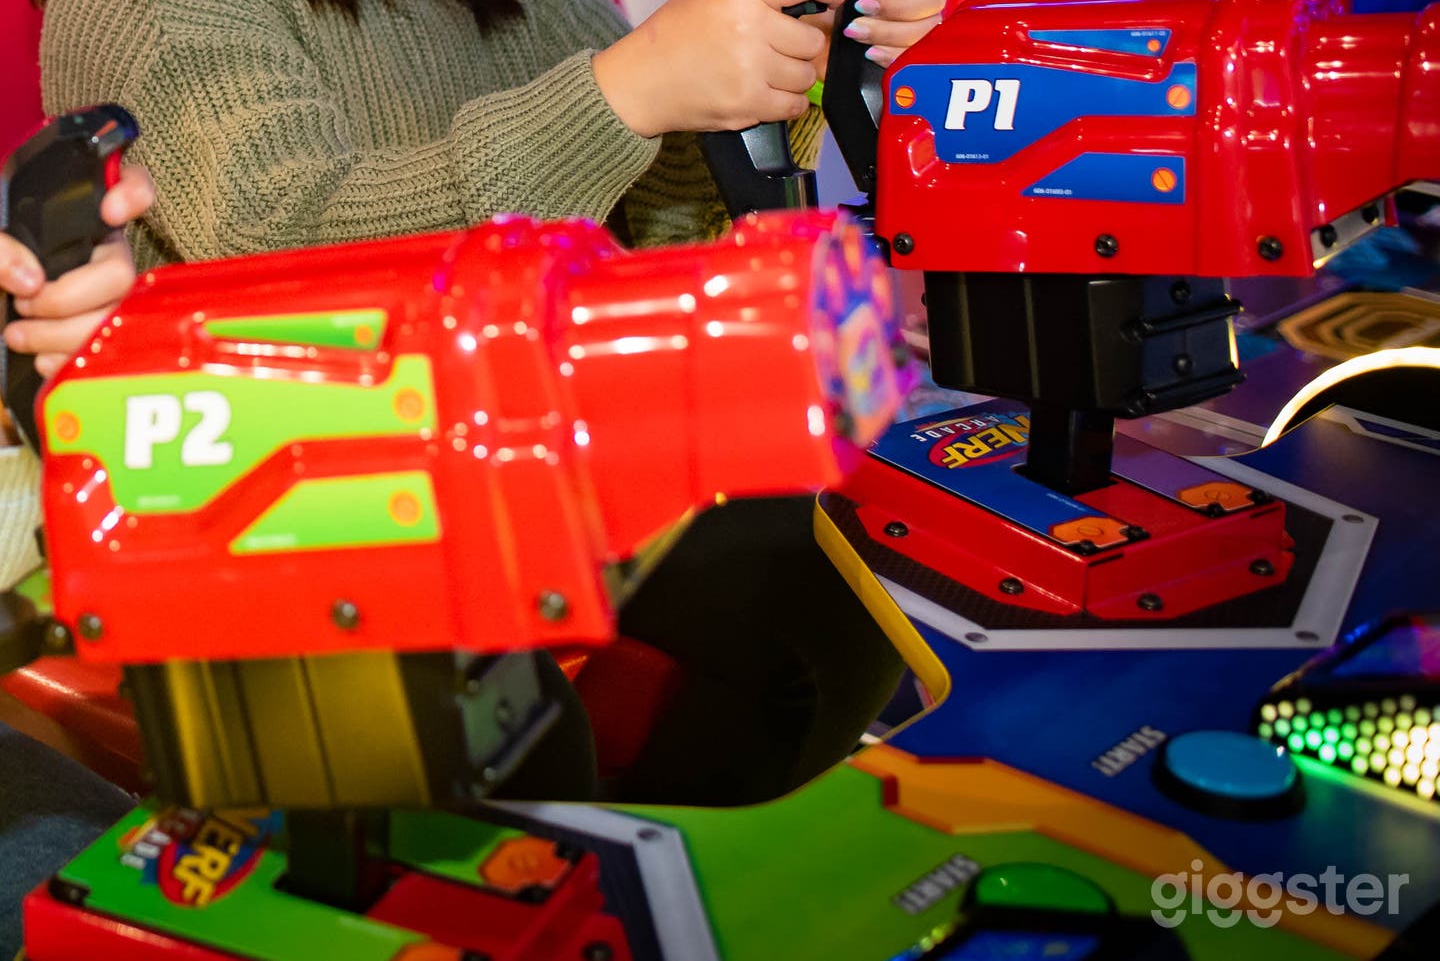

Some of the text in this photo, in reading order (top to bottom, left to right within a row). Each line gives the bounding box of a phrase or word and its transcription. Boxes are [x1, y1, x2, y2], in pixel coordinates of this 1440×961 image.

[944, 79, 1021, 131] P1
[124, 390, 234, 470] P2
[910, 415, 1001, 442] ARCADE
[942, 415, 1030, 469] NERF
